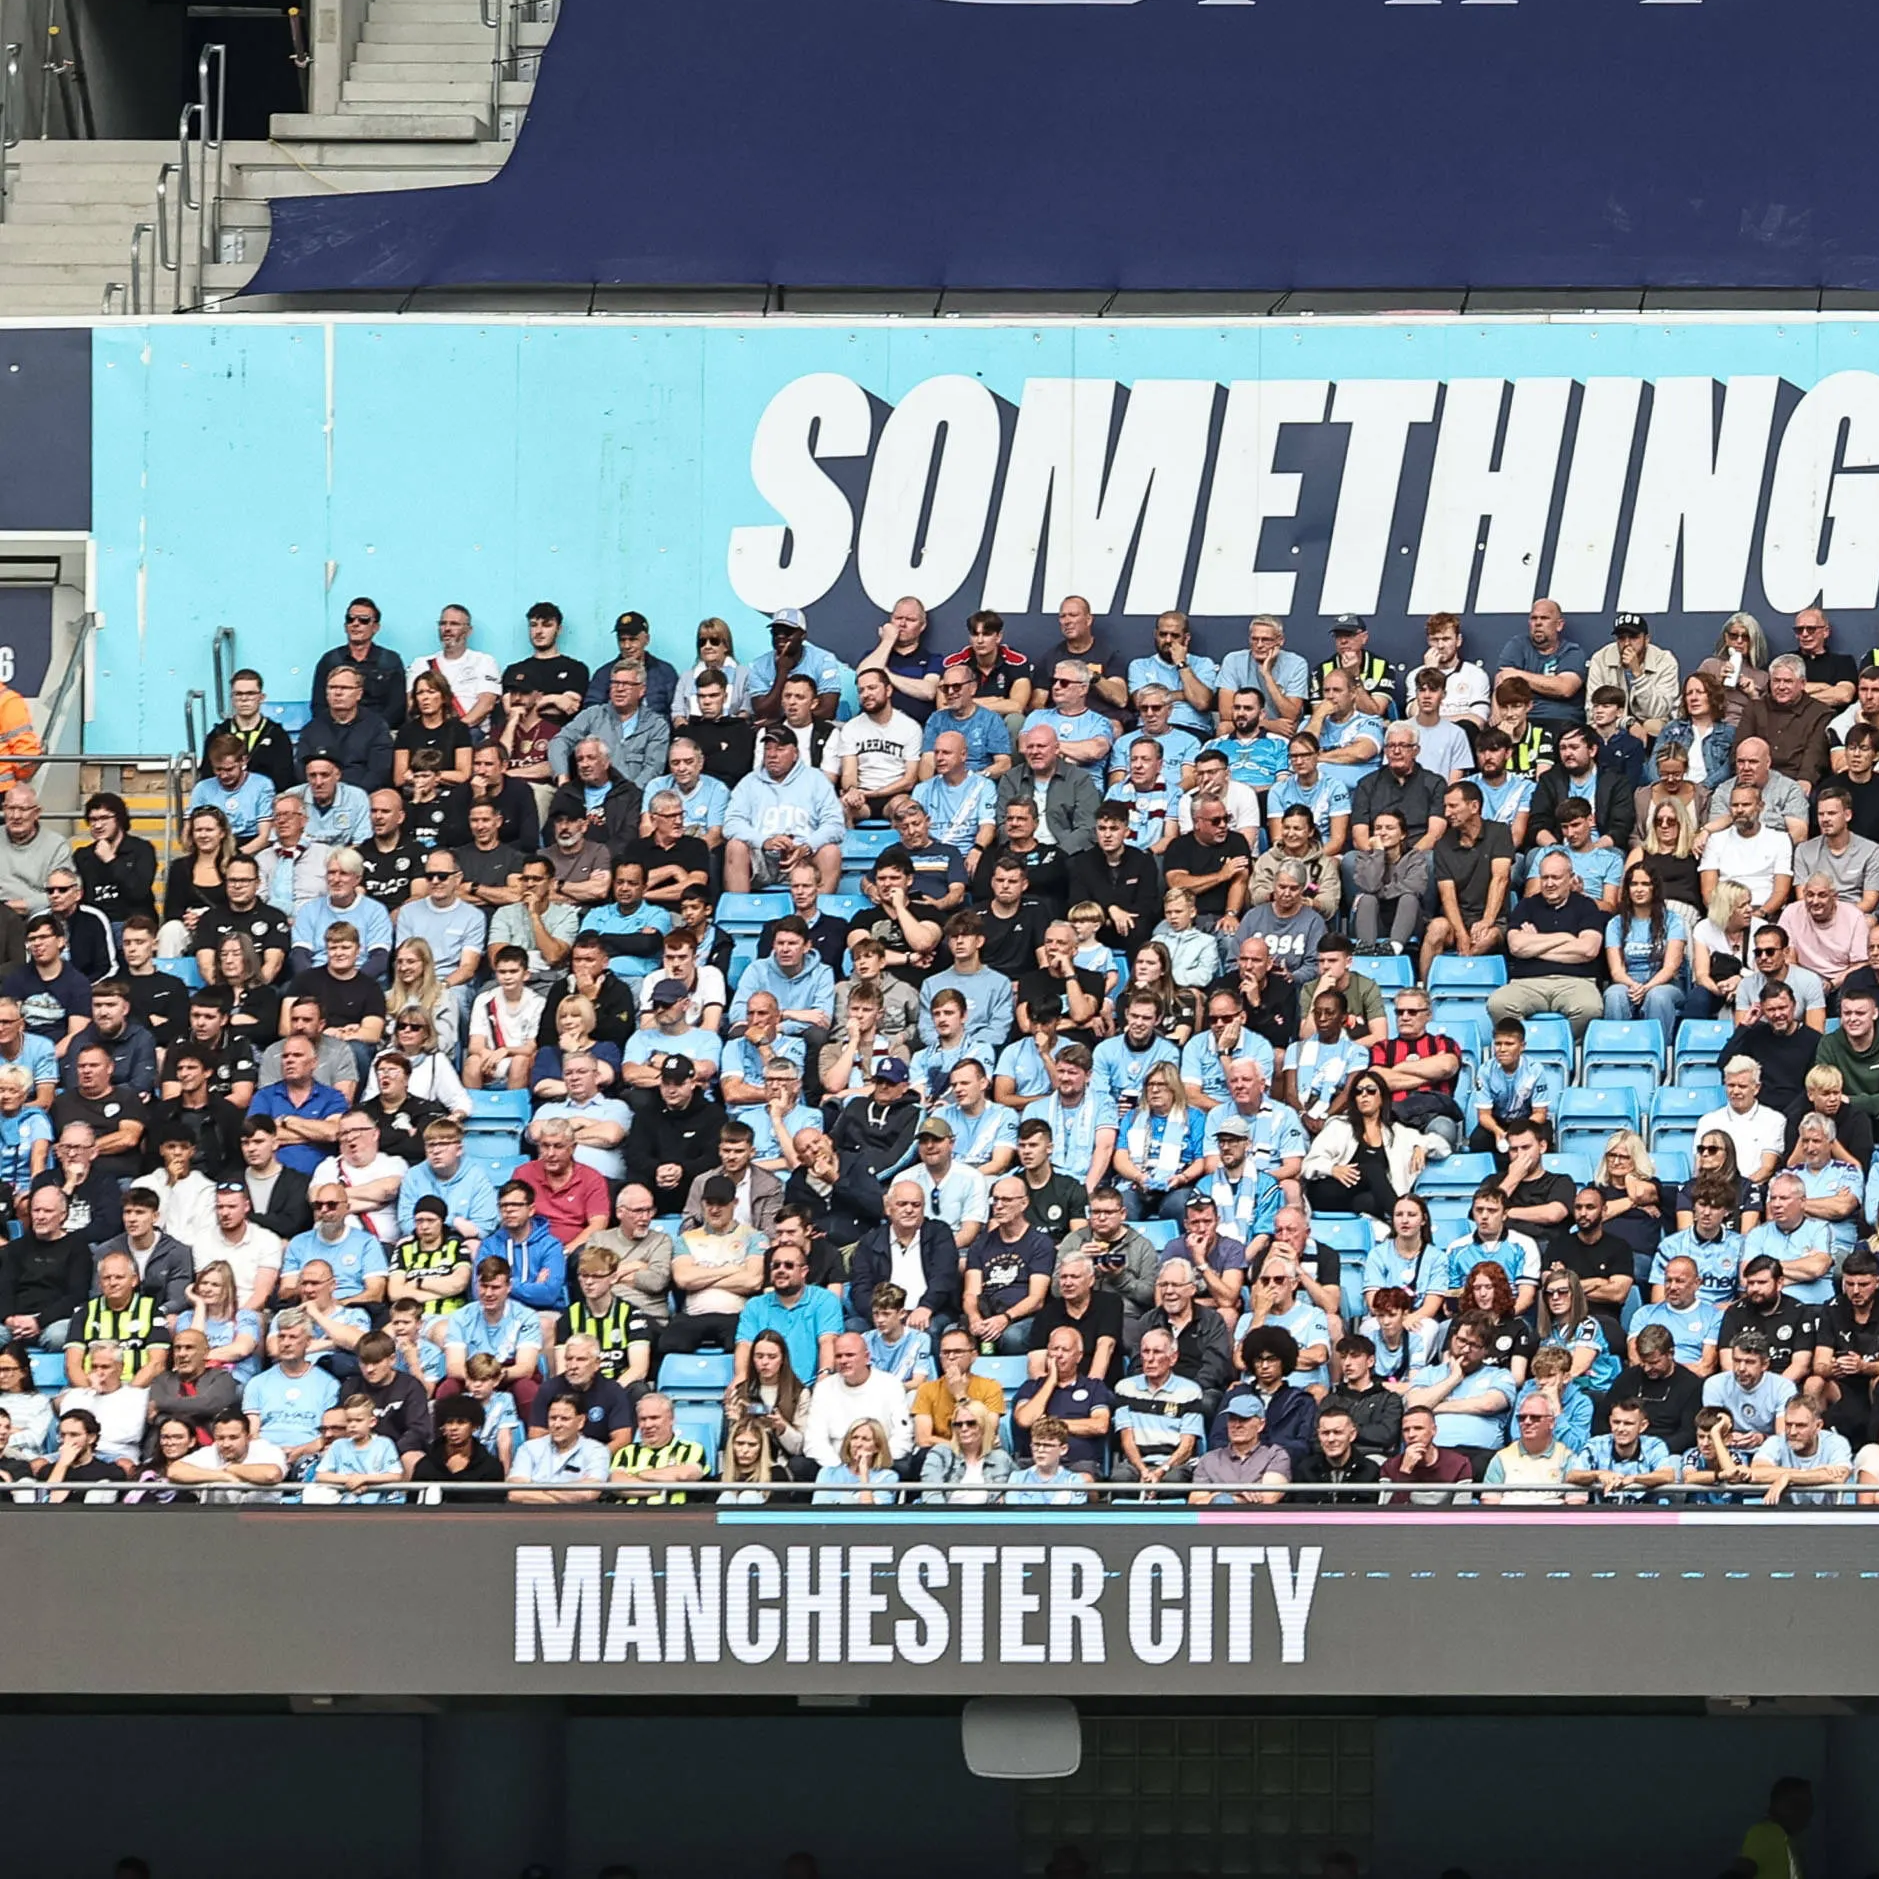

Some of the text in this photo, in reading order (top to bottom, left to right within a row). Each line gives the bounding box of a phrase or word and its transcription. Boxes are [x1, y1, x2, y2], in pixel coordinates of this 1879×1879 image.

[1254, 931, 1305, 956] 994
[514, 1544, 1323, 1664] MANCHESTER CITY
